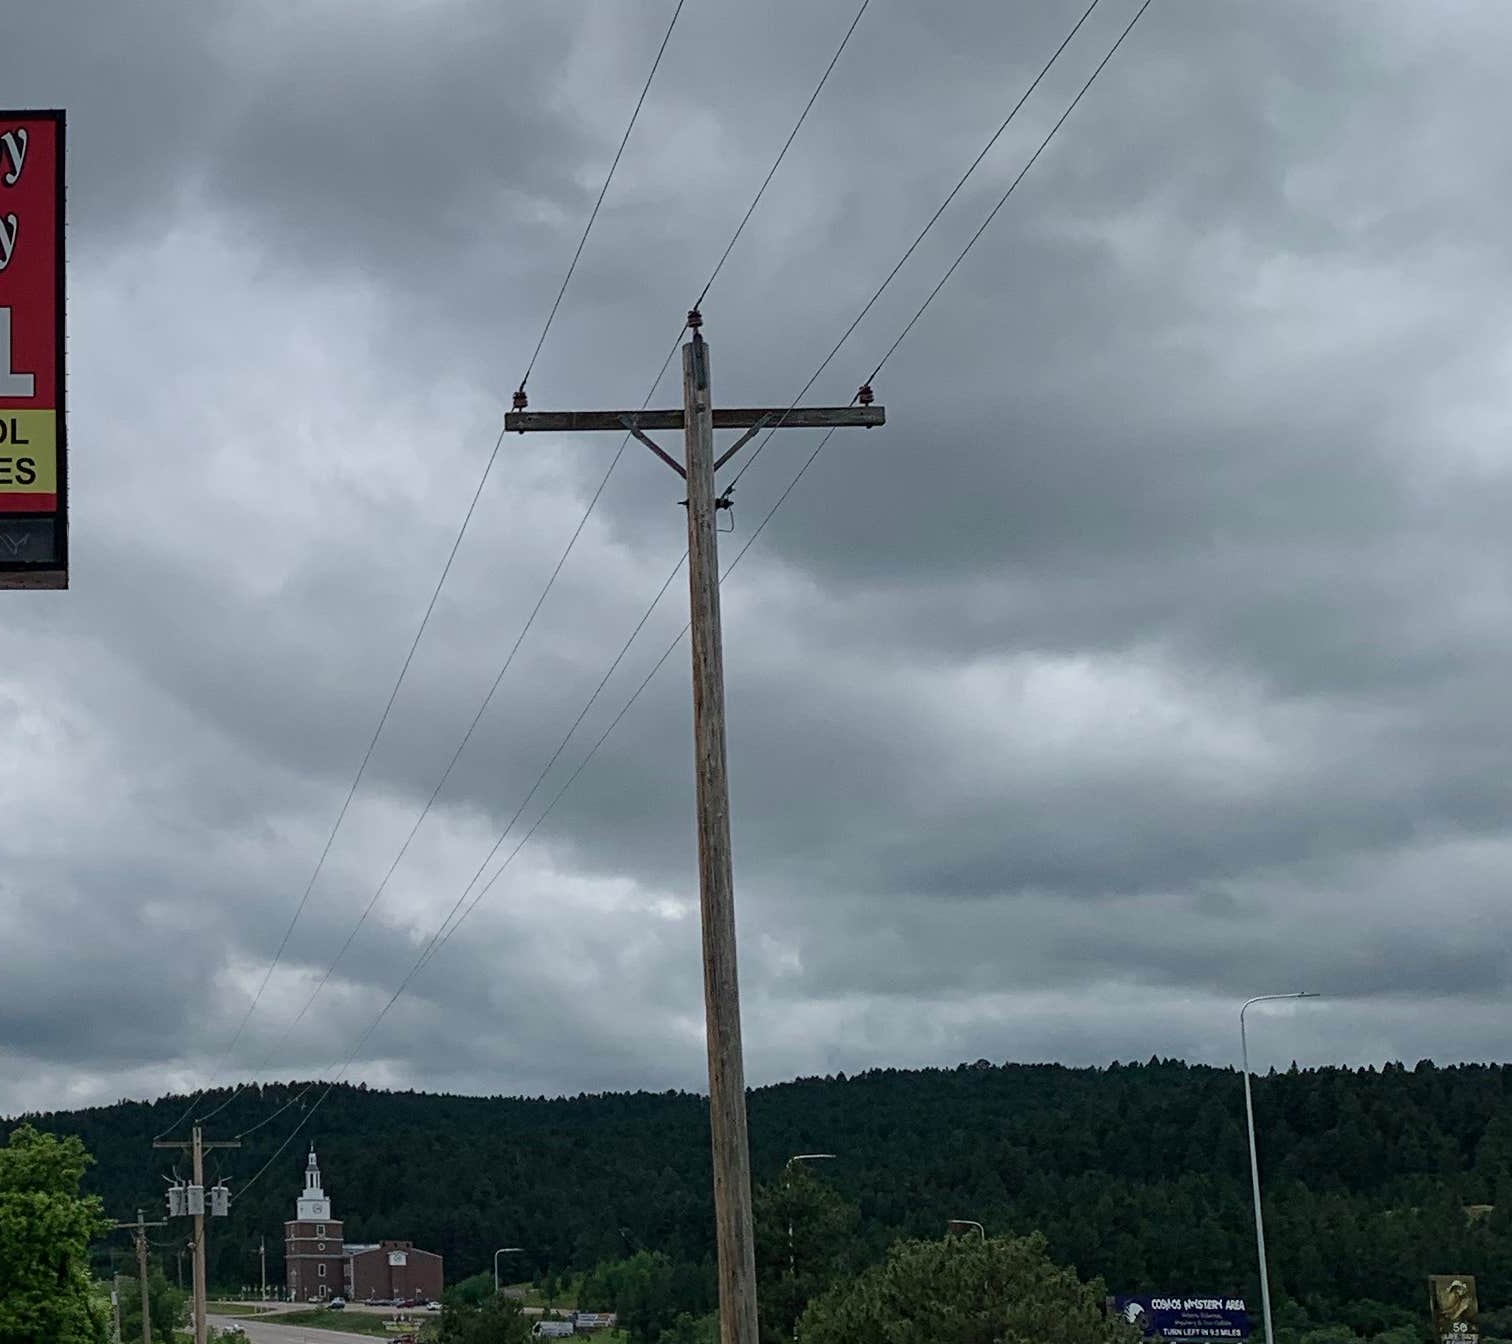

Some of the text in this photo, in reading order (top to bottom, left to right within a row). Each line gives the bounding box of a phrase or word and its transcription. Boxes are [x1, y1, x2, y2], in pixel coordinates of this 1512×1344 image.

[1151, 1299, 1245, 1311] COSMOS MYSTERY AREA
[1163, 1328, 1182, 1336] TURN
[1183, 1328, 1200, 1336] LEFT
